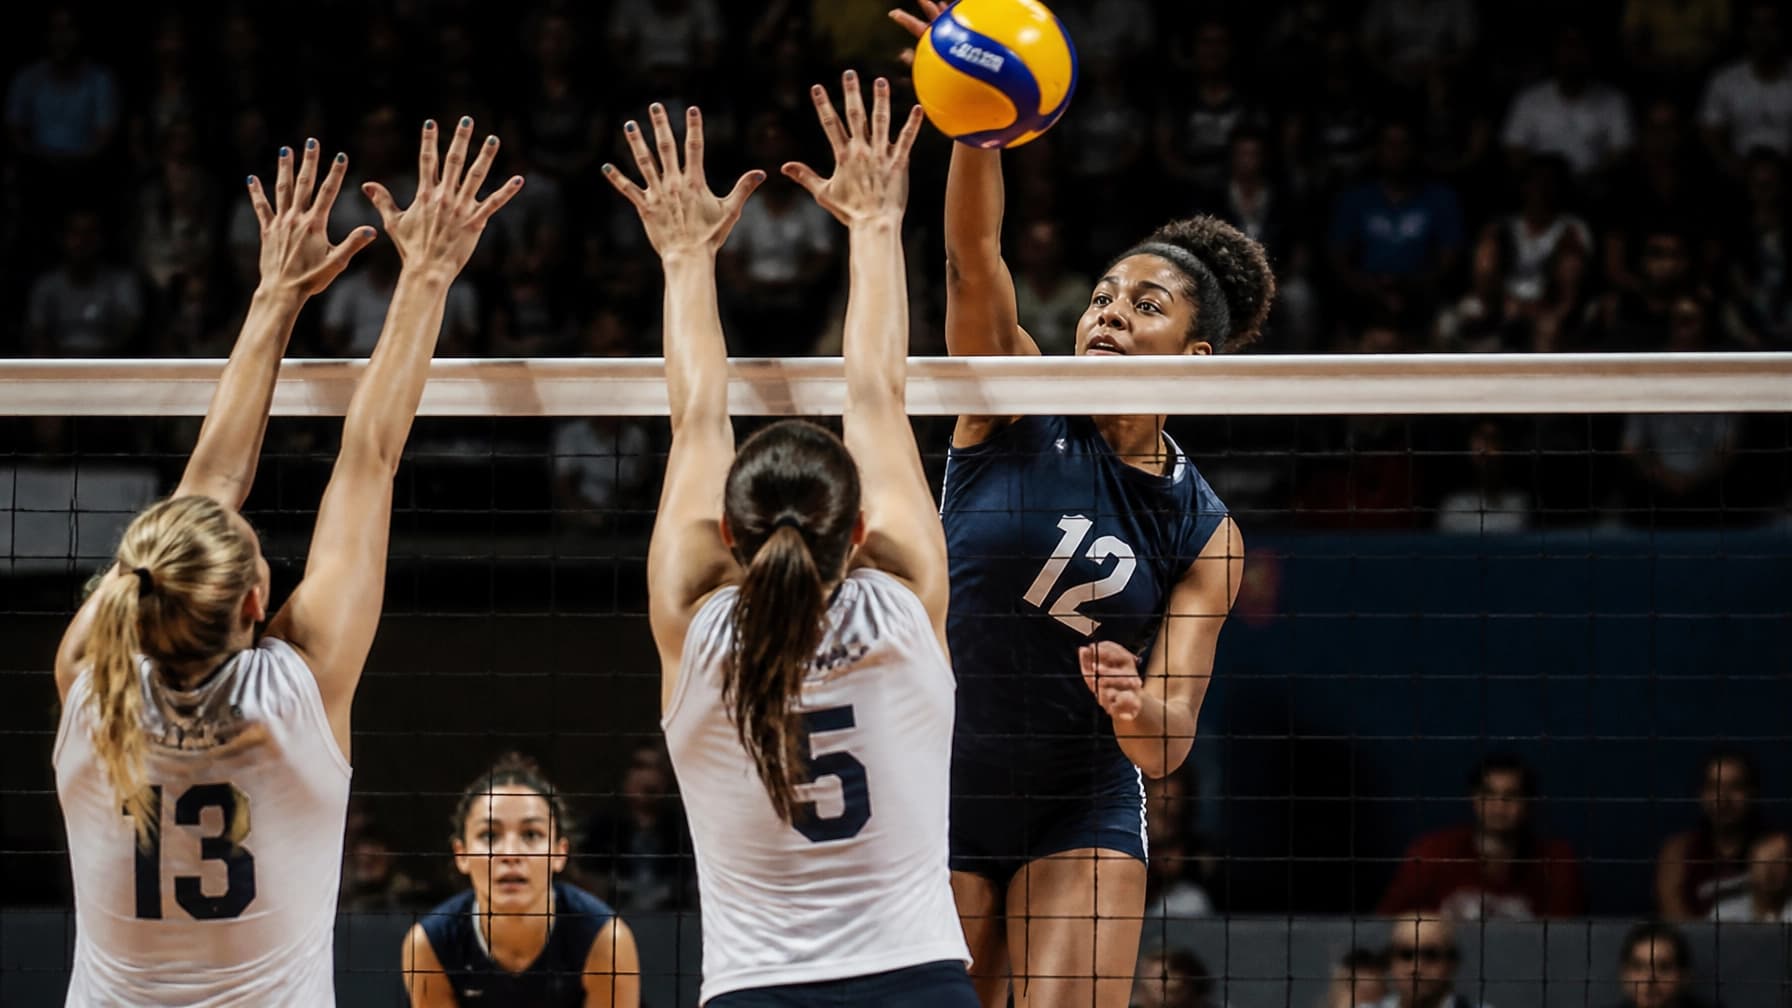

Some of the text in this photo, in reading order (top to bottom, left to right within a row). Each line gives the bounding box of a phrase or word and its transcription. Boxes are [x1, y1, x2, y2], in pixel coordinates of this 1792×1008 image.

[1023, 514, 1136, 636] 12
[790, 704, 872, 843] 5
[122, 783, 255, 920] 13
